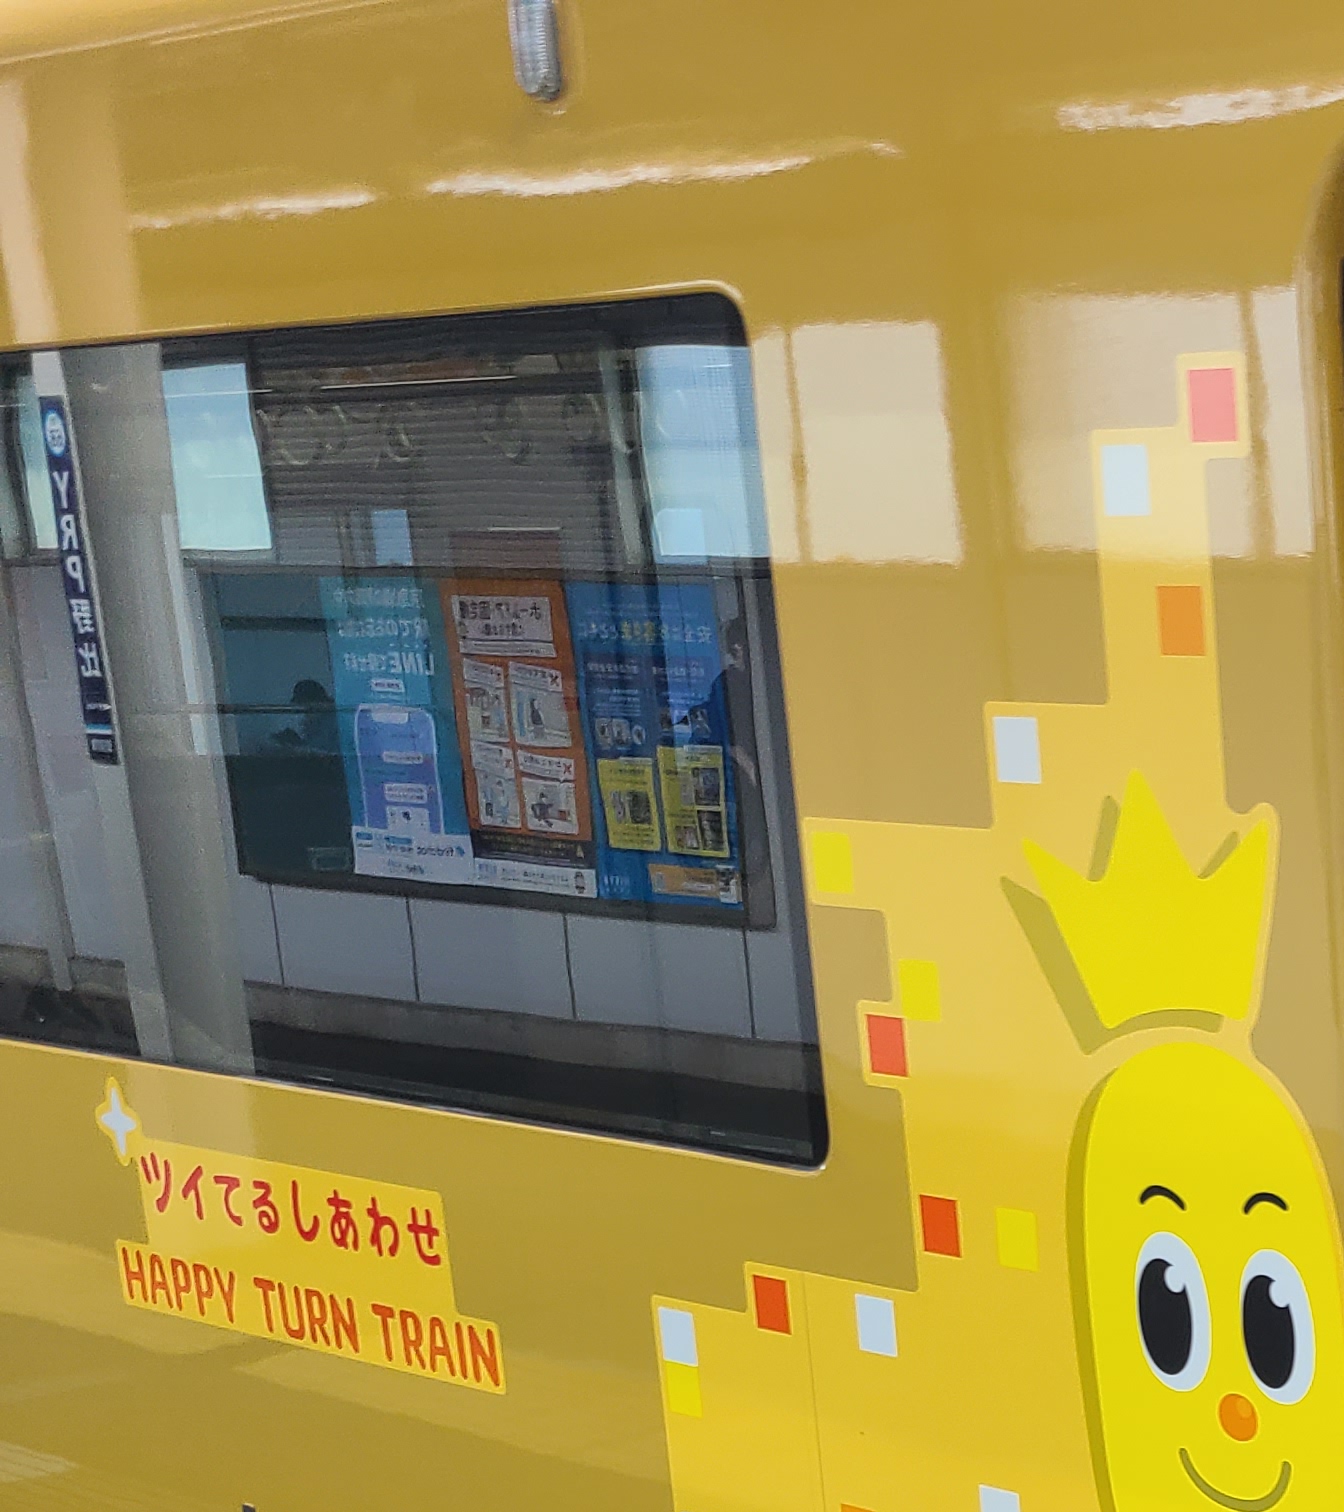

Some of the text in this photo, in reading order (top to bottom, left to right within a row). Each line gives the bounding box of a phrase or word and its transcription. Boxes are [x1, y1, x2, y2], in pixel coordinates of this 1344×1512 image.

[140, 1152, 441, 1266] ツイてるしあわせ
[122, 1246, 502, 1388] HAPPY TURN TRAIN
